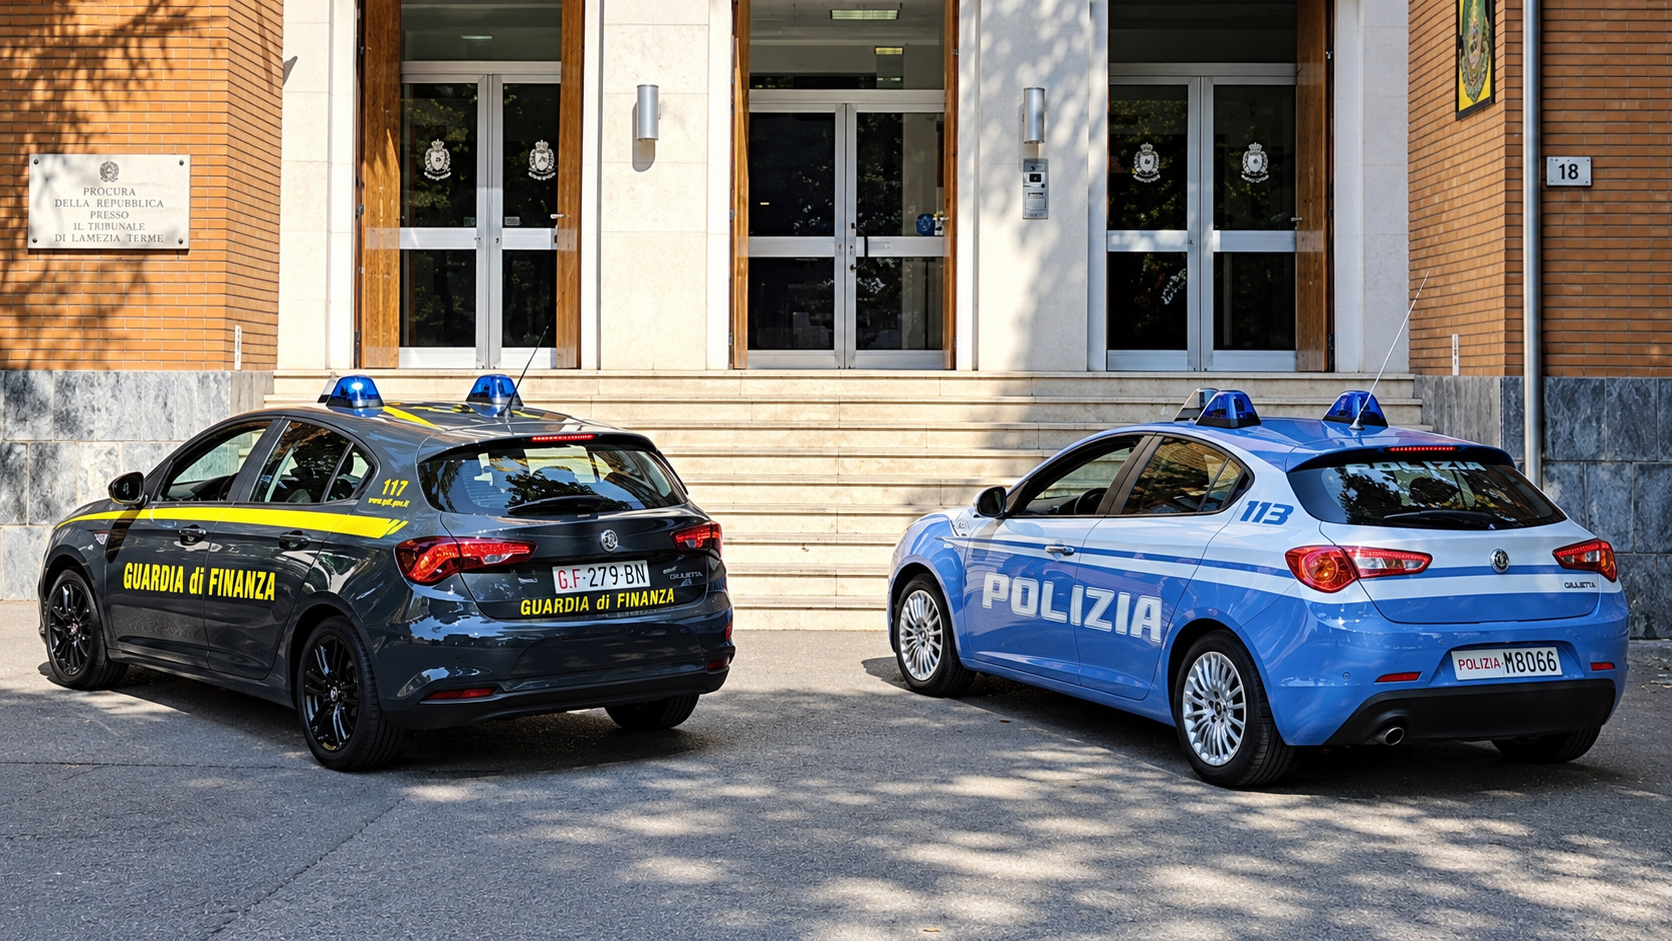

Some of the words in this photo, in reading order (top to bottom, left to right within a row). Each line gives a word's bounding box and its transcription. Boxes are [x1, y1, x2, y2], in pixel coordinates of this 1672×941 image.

[1558, 163, 1579, 180] 18
[83, 187, 136, 196] PROCURA
[54, 199, 90, 208] DELLA
[96, 199, 164, 208] REPUBBLICA
[90, 211, 129, 219] PRESSO
[73, 223, 84, 231] IL
[88, 222, 145, 231] TRIBUNALE
[54, 234, 66, 243] DI
[71, 234, 121, 243] LAMEZIA
[127, 234, 164, 243] TERME
[382, 478, 409, 496] 117
[1239, 500, 1294, 525] 113
[123, 562, 184, 594] GUARDIA
[189, 566, 205, 595] di
[208, 567, 276, 601] FINANZA
[520, 595, 590, 616] GUARDIA
[596, 594, 610, 610] di
[617, 588, 675, 608] FINANZA
[981, 571, 1162, 643] POLIZIA
